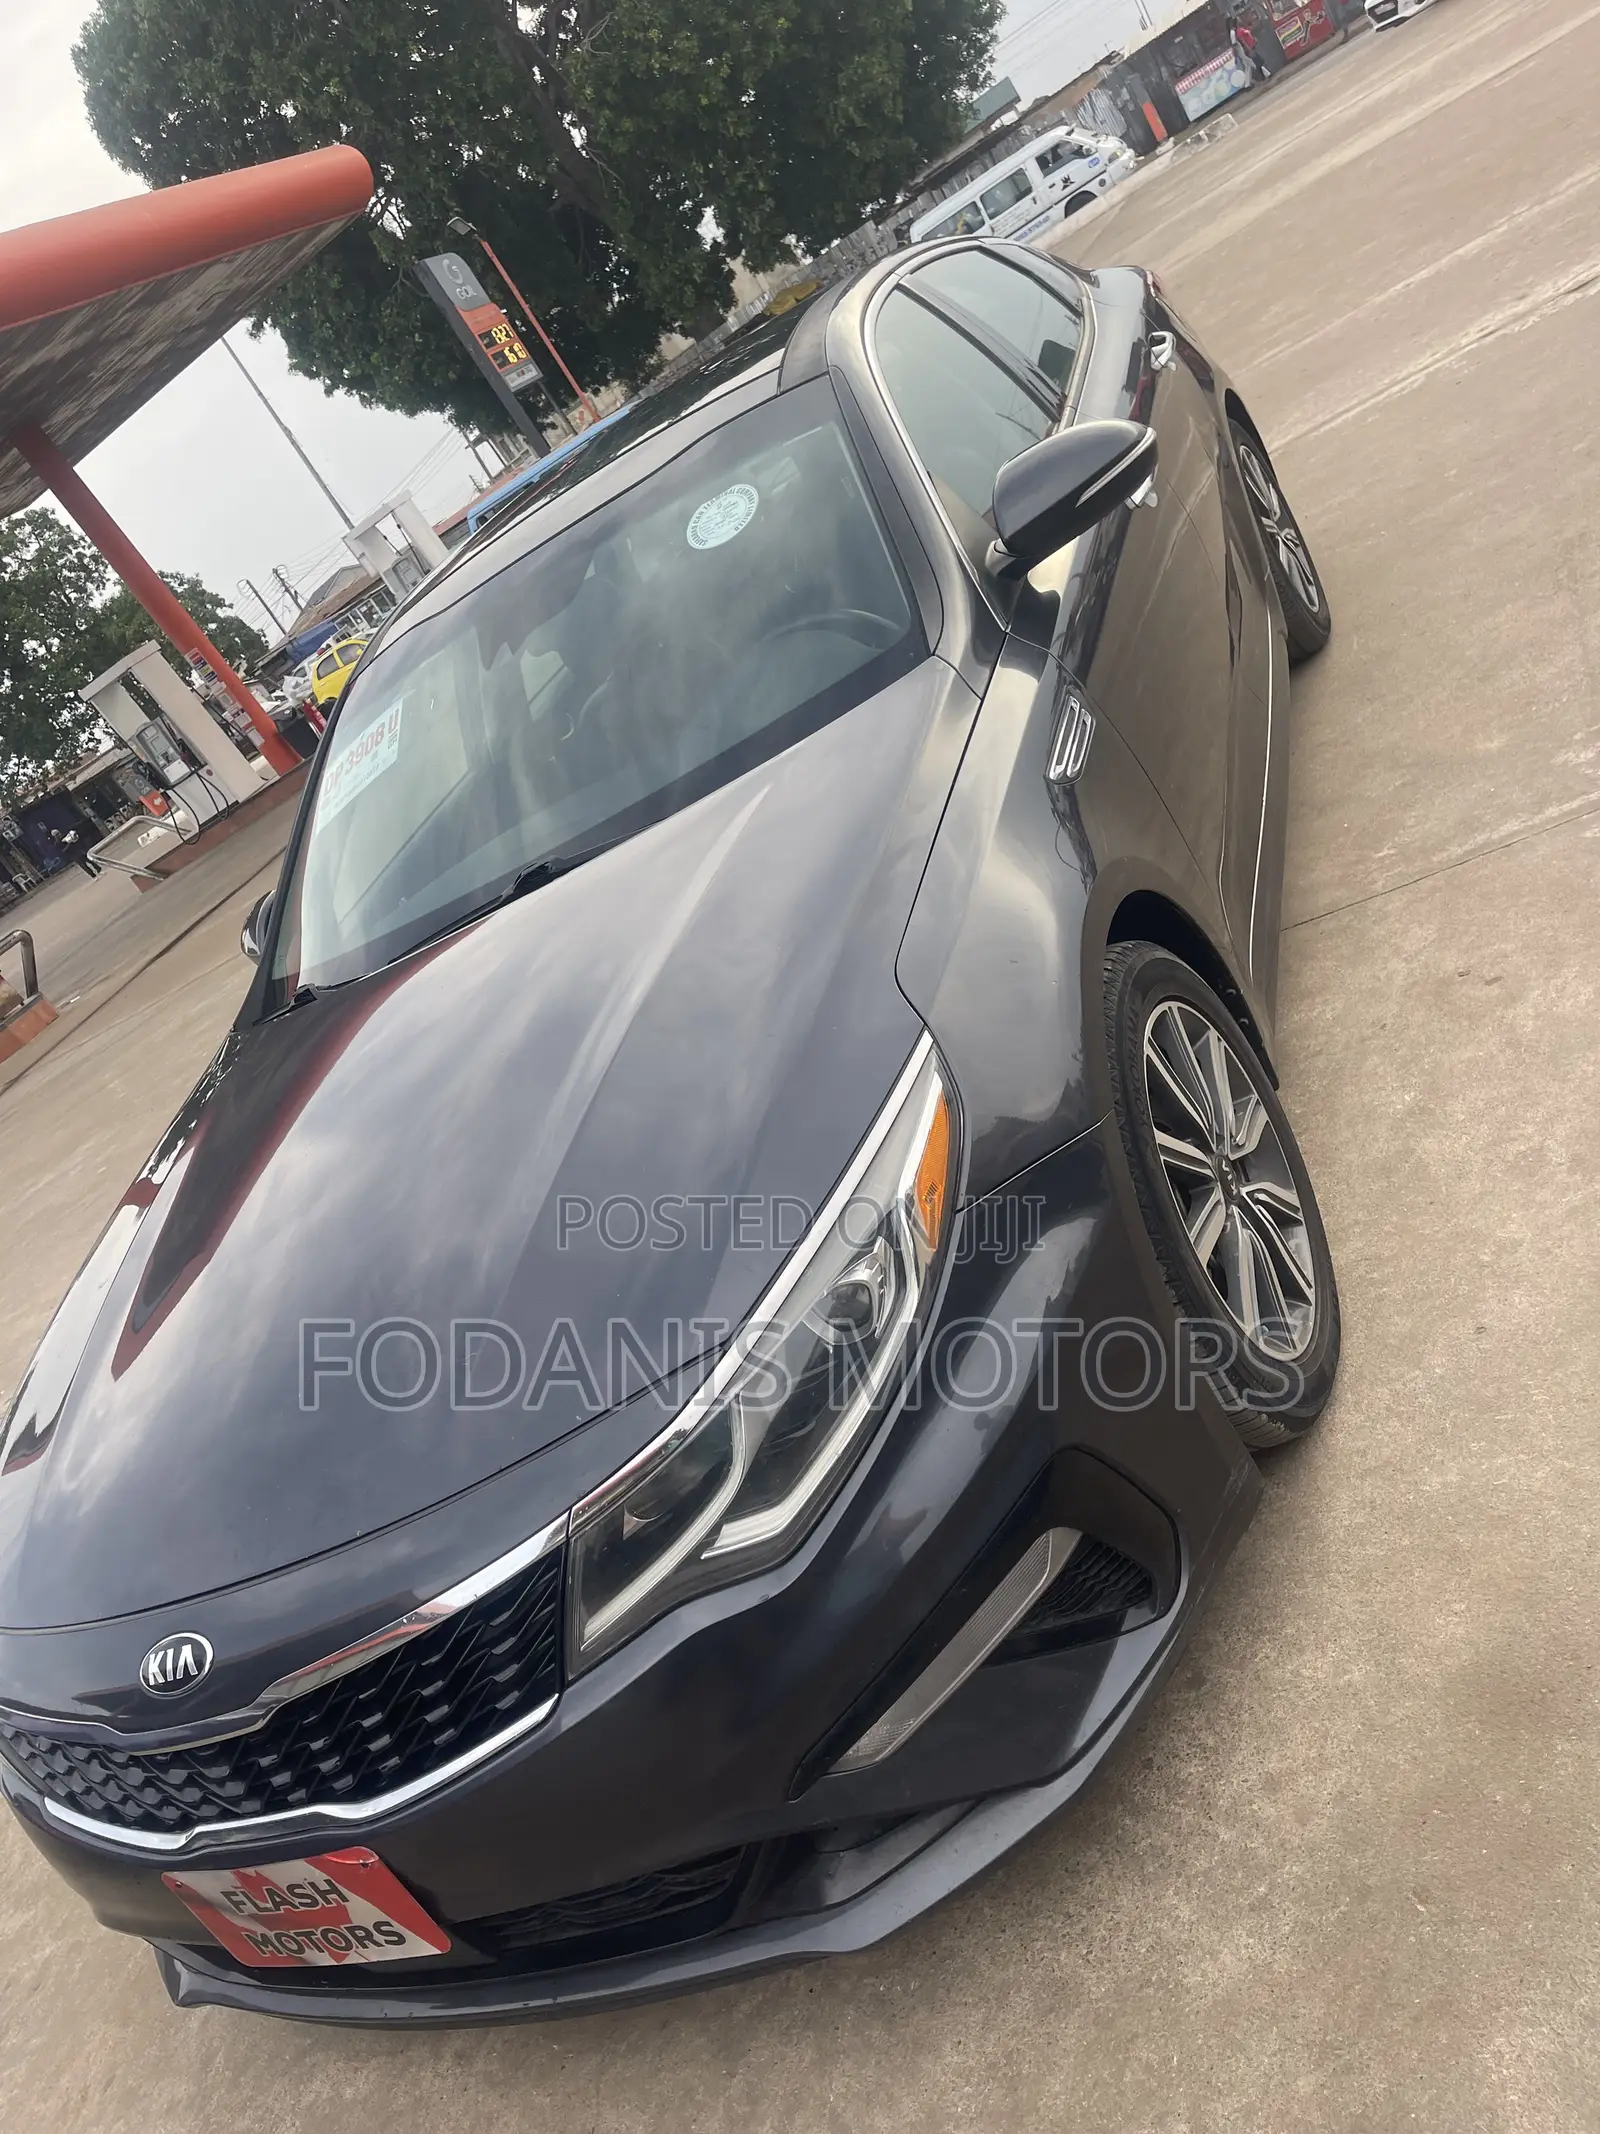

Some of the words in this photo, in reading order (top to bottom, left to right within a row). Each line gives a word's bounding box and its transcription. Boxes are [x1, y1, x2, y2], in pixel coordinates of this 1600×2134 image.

[344, 721, 386, 775] 3908
[148, 1643, 199, 1686] KIA
[220, 1878, 350, 1916] FLASH
[245, 1921, 407, 1957] MOTORS
